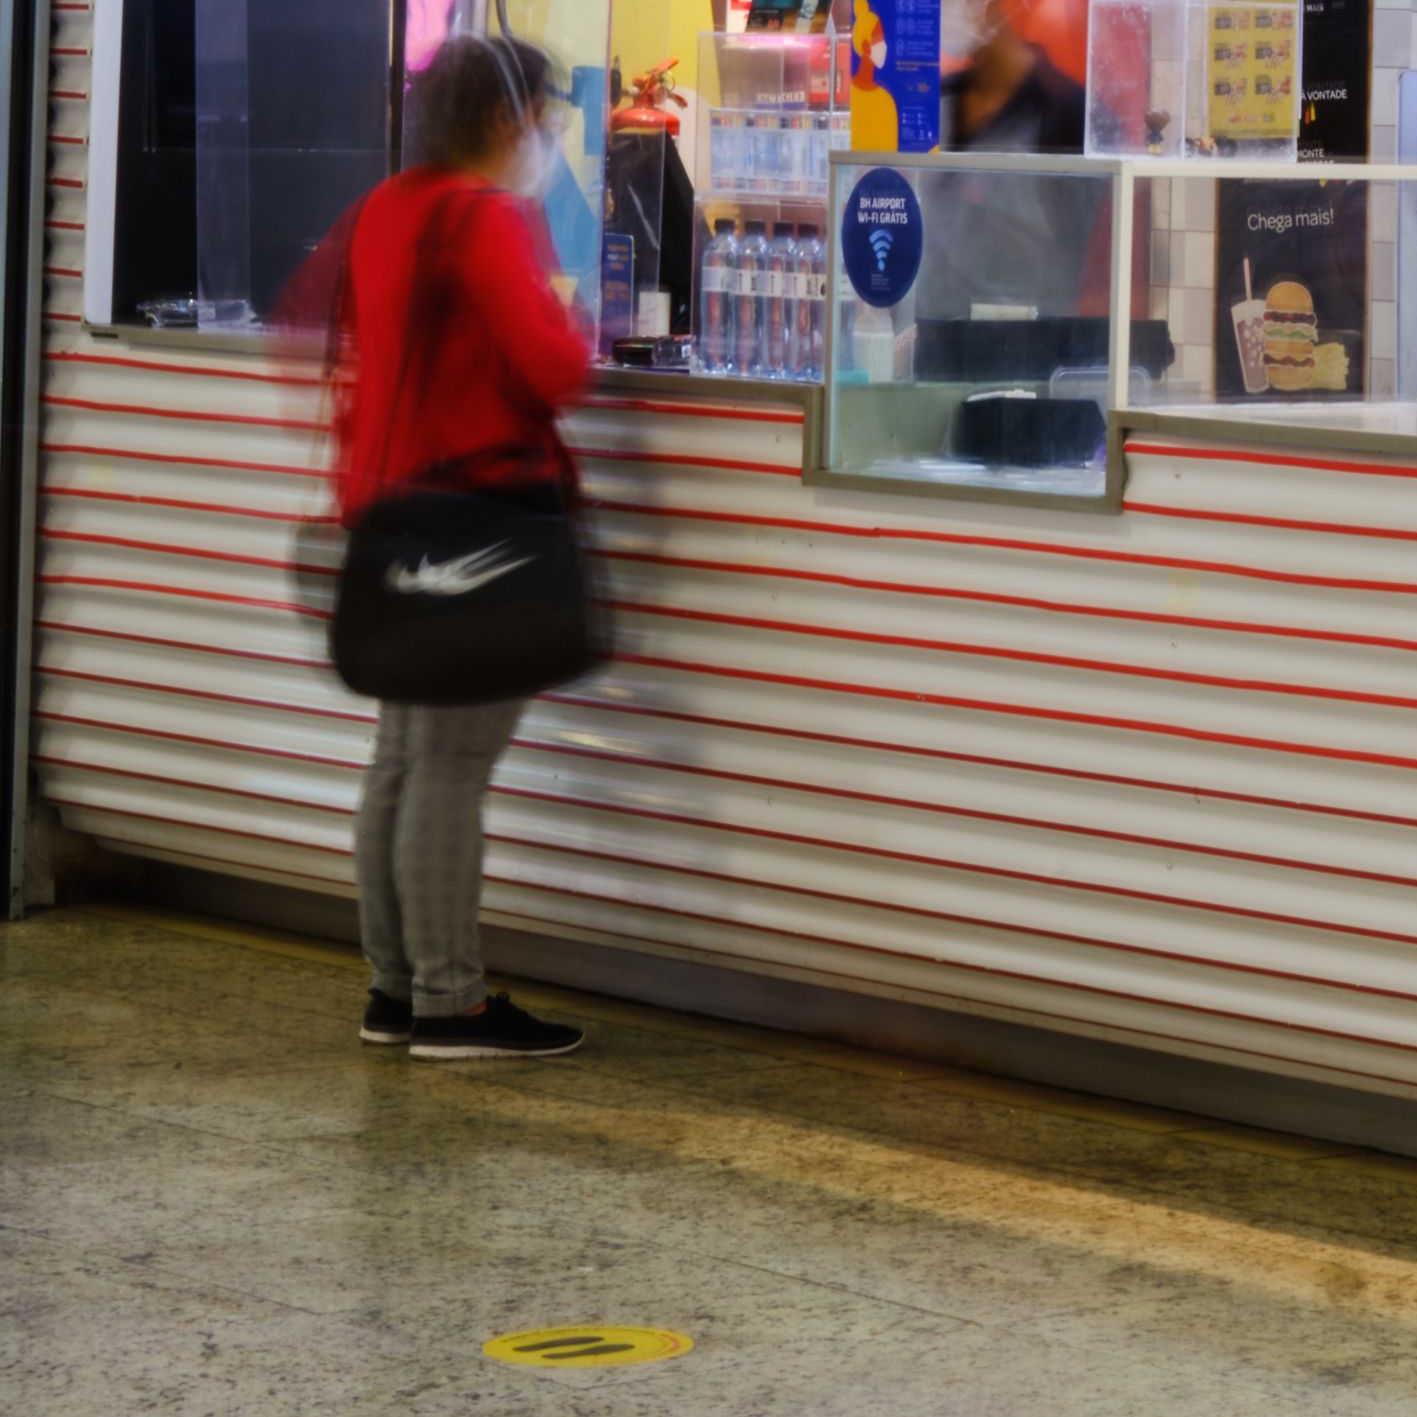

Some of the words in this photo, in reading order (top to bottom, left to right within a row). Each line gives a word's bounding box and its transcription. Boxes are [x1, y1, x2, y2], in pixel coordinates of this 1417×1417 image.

[1307, 88, 1348, 101] VONTADE
[871, 197, 906, 210] AIRPORT
[858, 211, 879, 224] WI-FI
[879, 210, 908, 225] GRÁTIS
[1247, 212, 1293, 234] Chega
[1295, 207, 1334, 227] mais!
